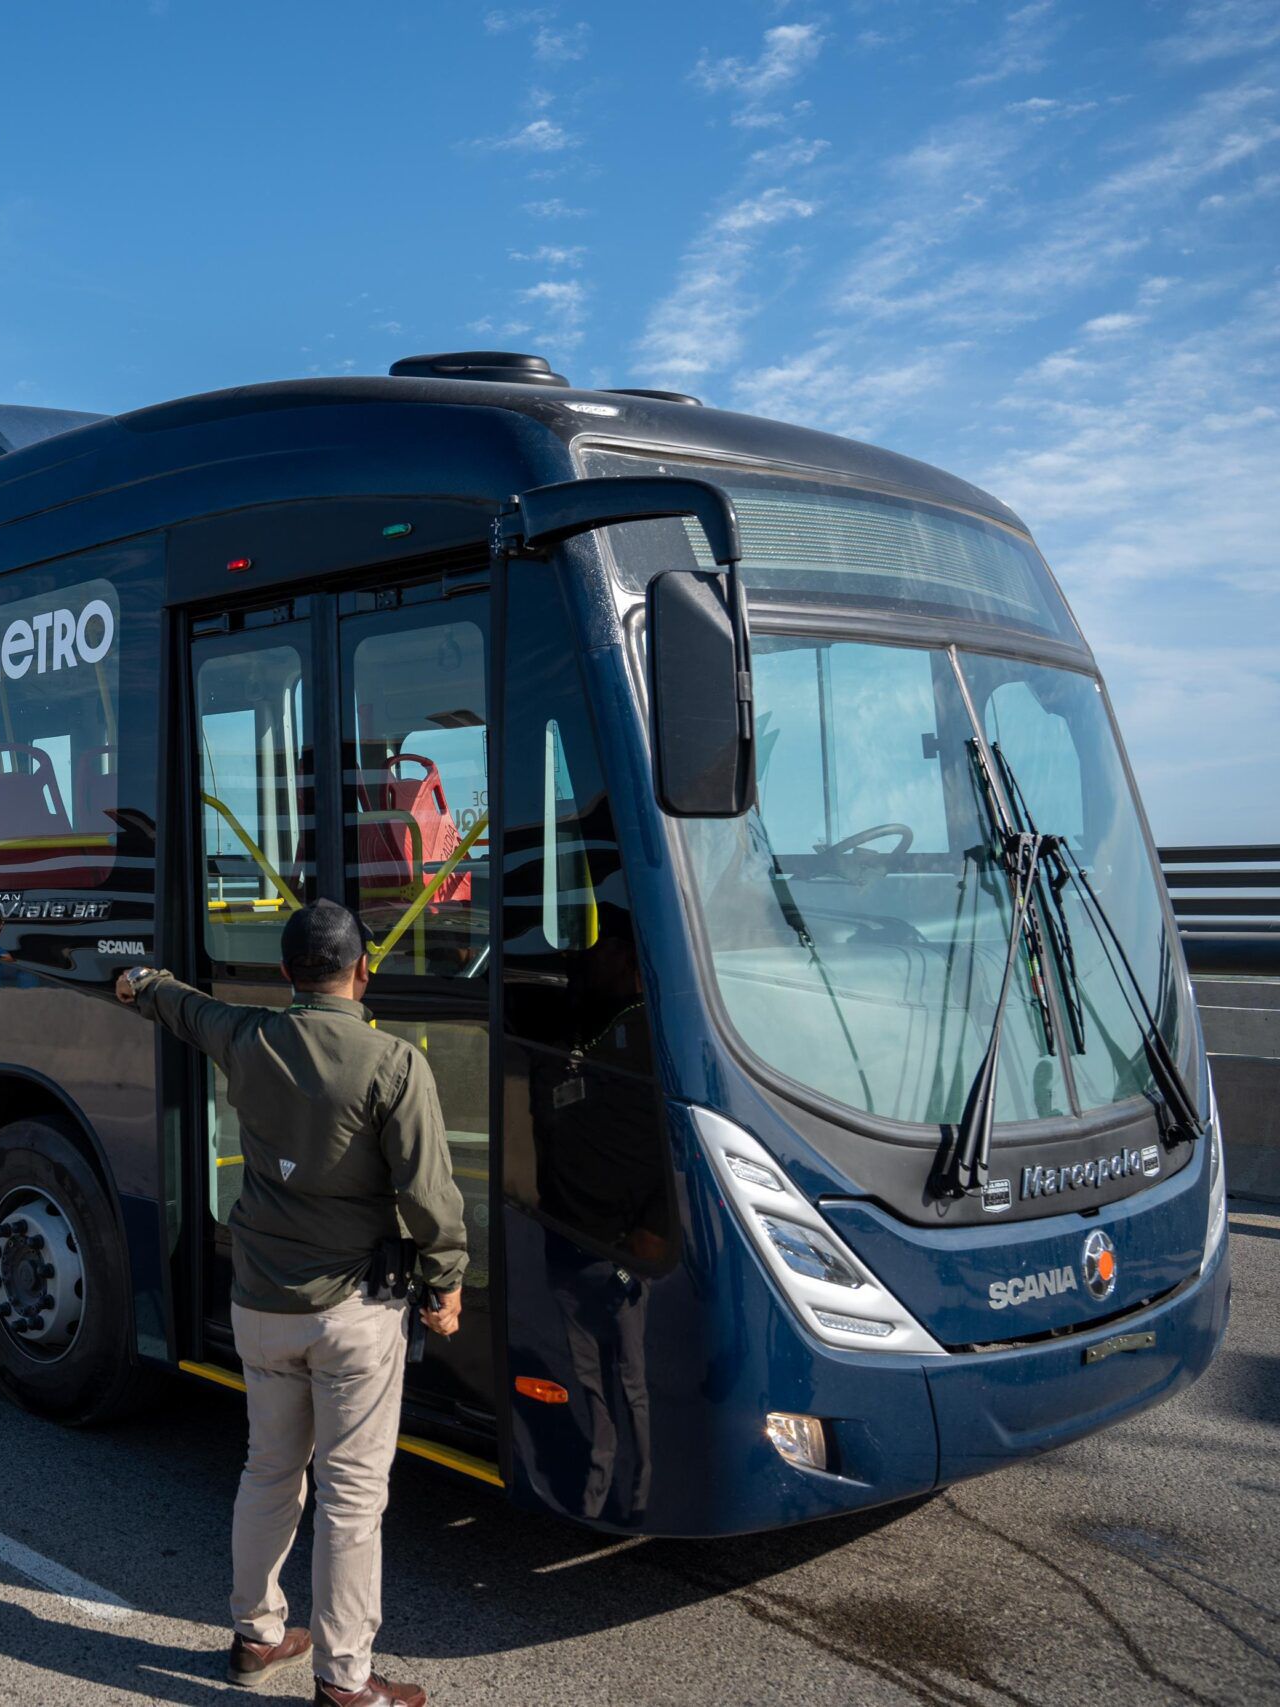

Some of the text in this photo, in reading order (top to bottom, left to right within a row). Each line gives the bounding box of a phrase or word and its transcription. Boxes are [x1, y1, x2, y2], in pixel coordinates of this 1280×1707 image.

[0, 902, 110, 919] Viale BRT
[97, 940, 145, 955] SCANIA
[1022, 1148, 1140, 1199] Marcopolo
[988, 1266, 1078, 1310] SCANIA
